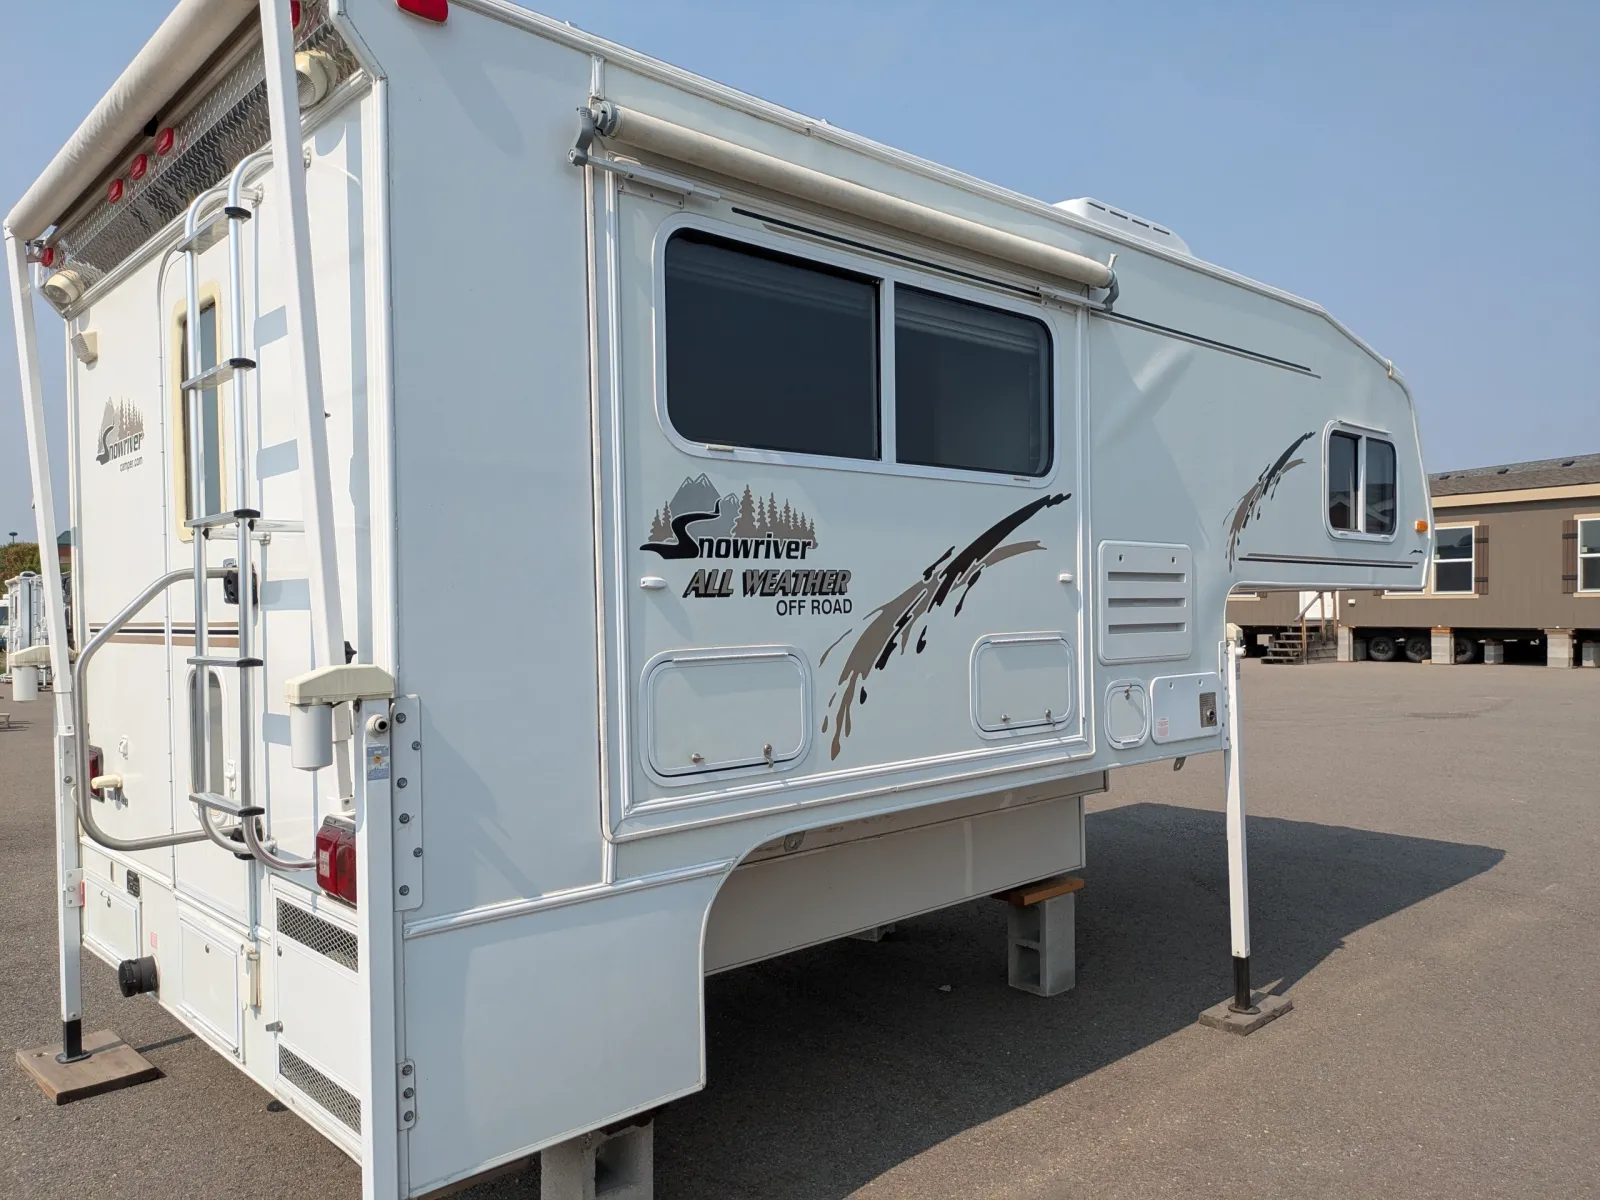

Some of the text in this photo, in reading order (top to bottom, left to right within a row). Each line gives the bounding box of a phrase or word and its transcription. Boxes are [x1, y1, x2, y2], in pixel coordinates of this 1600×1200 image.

[96, 422, 143, 465] Snowriver
[639, 498, 812, 560] Snowriver
[682, 568, 852, 598] ALL WEATHER
[776, 598, 852, 616] OFF ROAD
